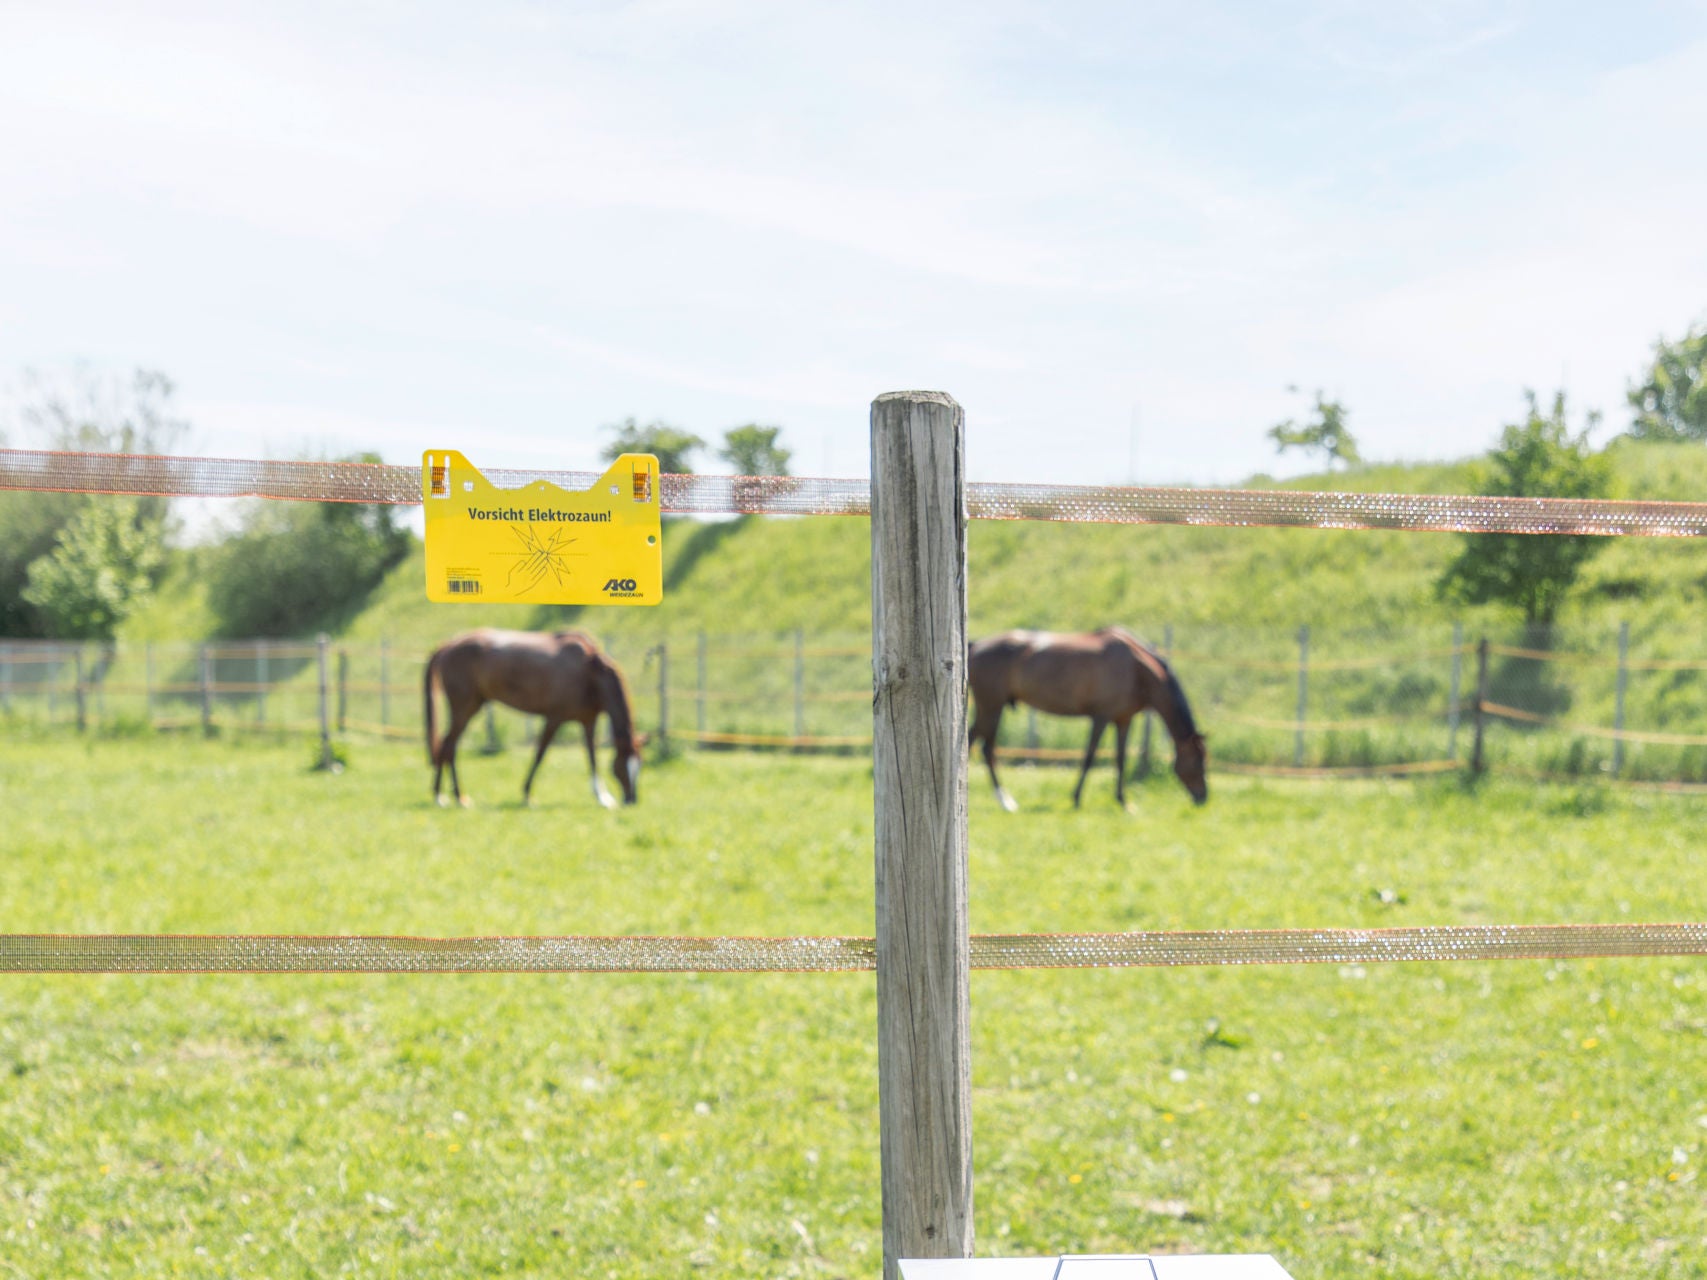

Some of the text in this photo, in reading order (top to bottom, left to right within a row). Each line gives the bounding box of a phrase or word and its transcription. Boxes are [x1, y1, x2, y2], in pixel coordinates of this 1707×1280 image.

[468, 507, 612, 522] Vorsicht Elektrozaun!
[602, 579, 637, 591] AKO
